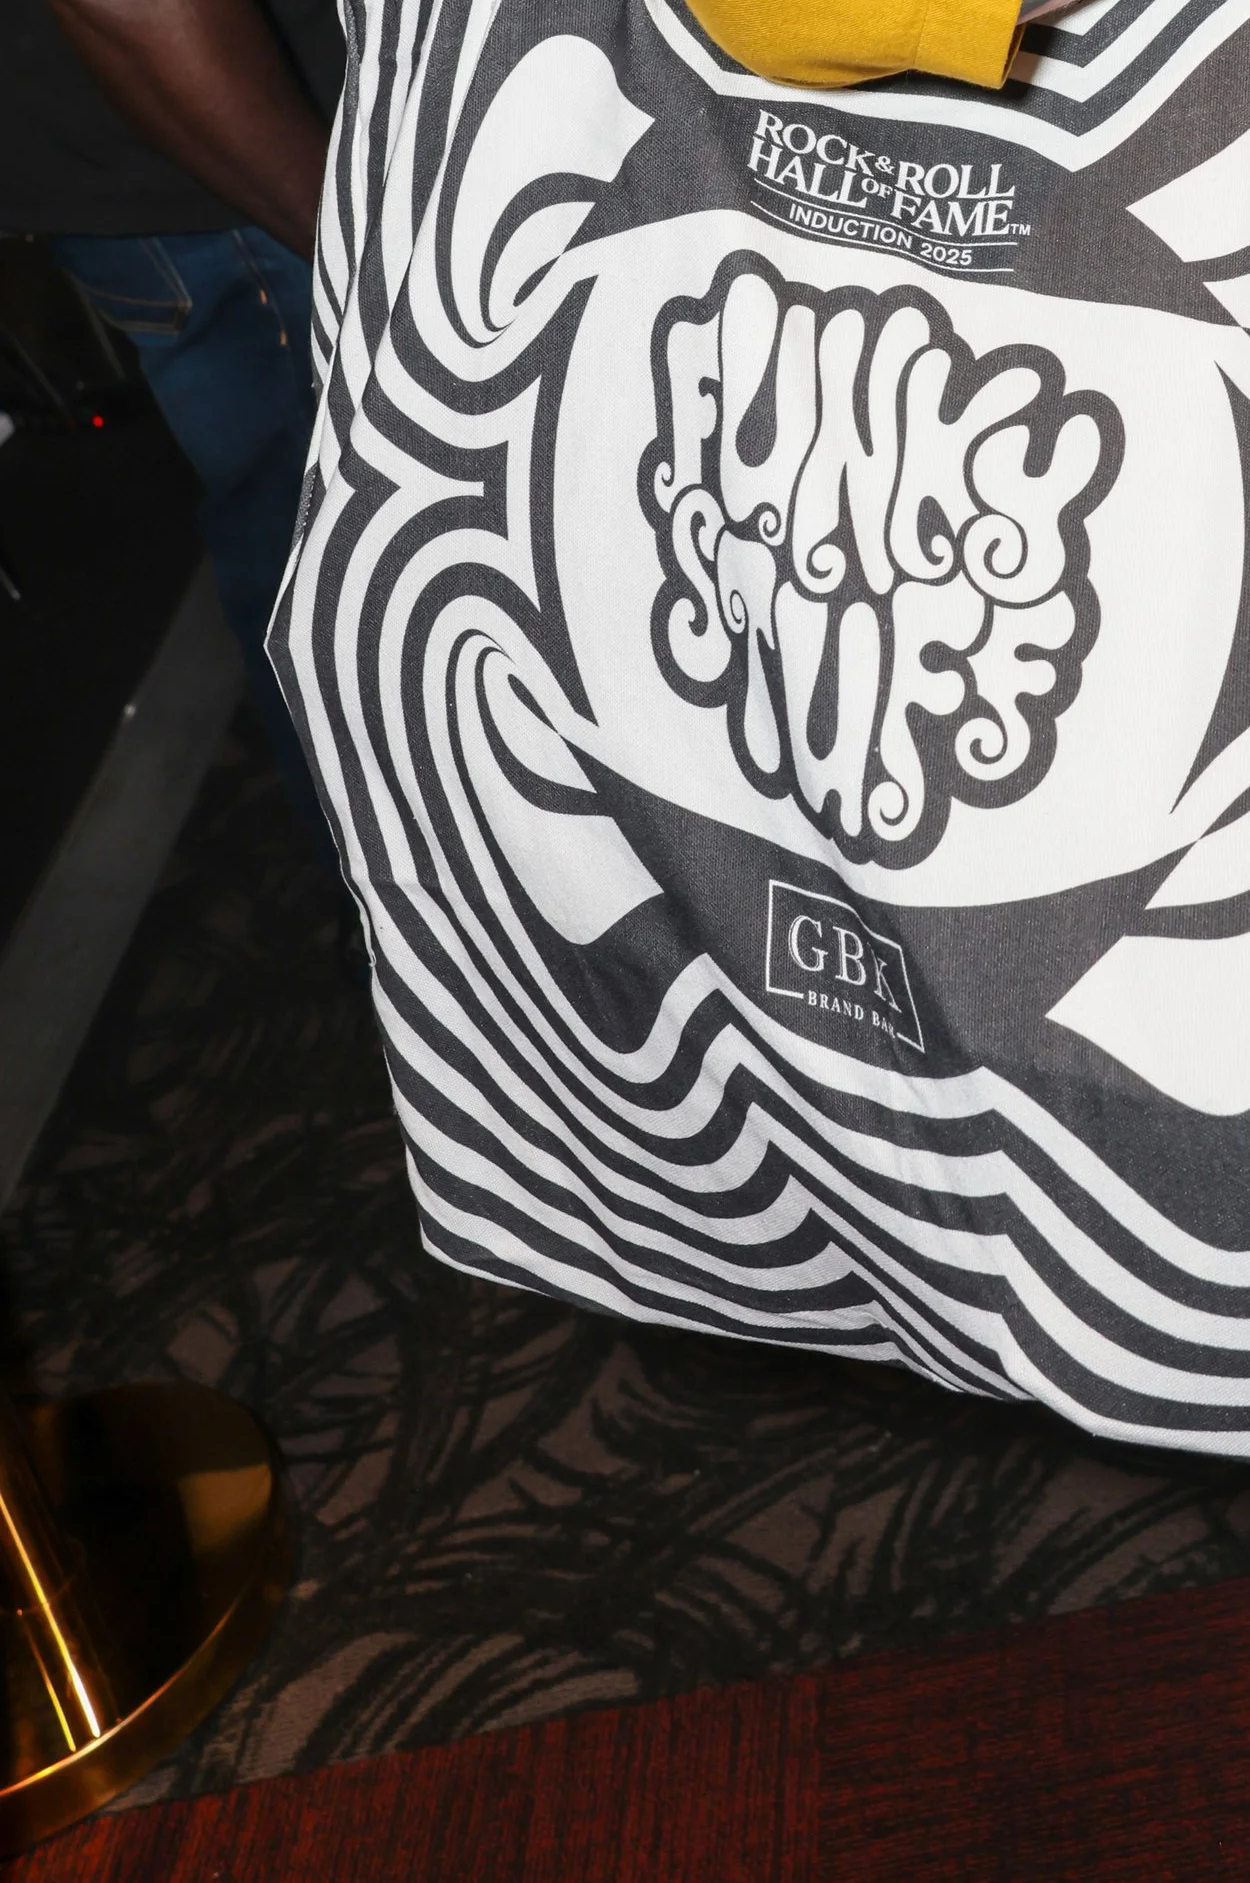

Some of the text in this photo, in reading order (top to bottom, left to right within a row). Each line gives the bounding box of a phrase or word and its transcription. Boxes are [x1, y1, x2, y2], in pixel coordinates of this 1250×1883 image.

[746, 136, 868, 210] HALL
[861, 177, 895, 199] OF
[754, 109, 876, 177] ROCK
[895, 160, 1015, 200] ROLL
[789, 203, 973, 267] INDUCTION 2025
[652, 272, 1102, 604] FUNKY
[668, 485, 1076, 843] STUFF
[788, 914, 903, 1014] GBK
[808, 990, 897, 1040] BRAND BAR
